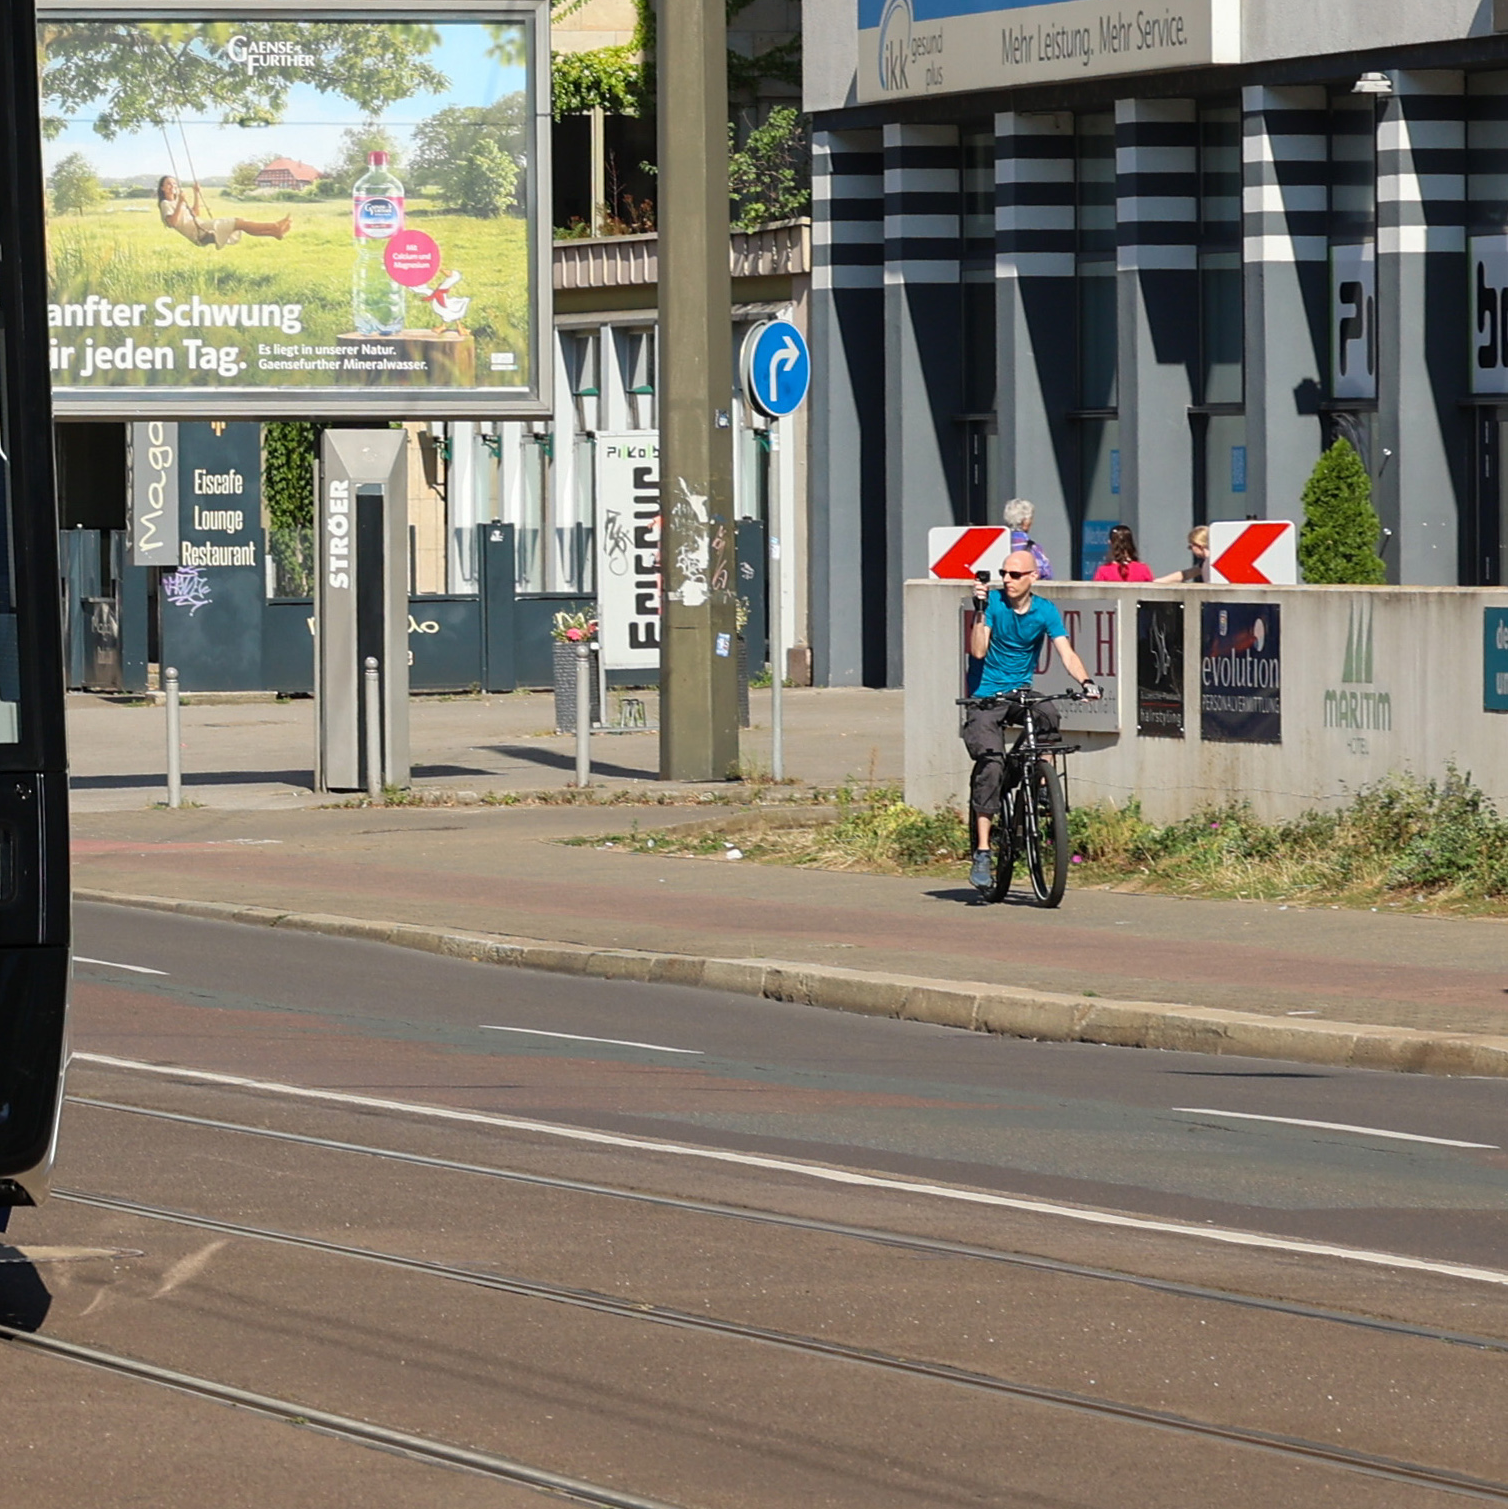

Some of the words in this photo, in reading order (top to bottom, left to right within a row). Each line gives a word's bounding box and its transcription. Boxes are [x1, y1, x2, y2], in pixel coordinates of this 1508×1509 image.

[911, 26, 943, 64] gesund
[1001, 24, 1033, 65] Mehr
[1037, 20, 1094, 67] Leistung.
[1099, 11, 1132, 54] Mehr
[1136, 8, 1188, 51] Service.
[247, 55, 315, 76] FURTHER
[884, 39, 909, 91] ikk
[925, 61, 943, 89] plus
[393, 261, 430, 270] Magnesium
[154, 295, 302, 334] Schwung
[80, 338, 174, 377] jeden
[182, 339, 247, 377] Tag.
[258, 345, 271, 355] Es
[273, 344, 299, 357] liegt
[301, 344, 313, 355] in
[315, 346, 359, 355] unserer
[362, 344, 396, 355] Natur.
[258, 358, 340, 370] Gaensefurther
[343, 358, 428, 370] Mineralwasser.
[194, 469, 243, 495] Eiscafe
[194, 506, 243, 534] Lounge
[327, 480, 349, 589] STRÖER
[182, 541, 256, 566] Restaurant
[1202, 648, 1279, 689] evolution
[1202, 694, 1280, 713] PERSONALVERMITTLUNG
[1324, 689, 1392, 732] MARITIM
[1140, 709, 1181, 727] hairstyling
[1346, 737, 1369, 755] HOTEL
